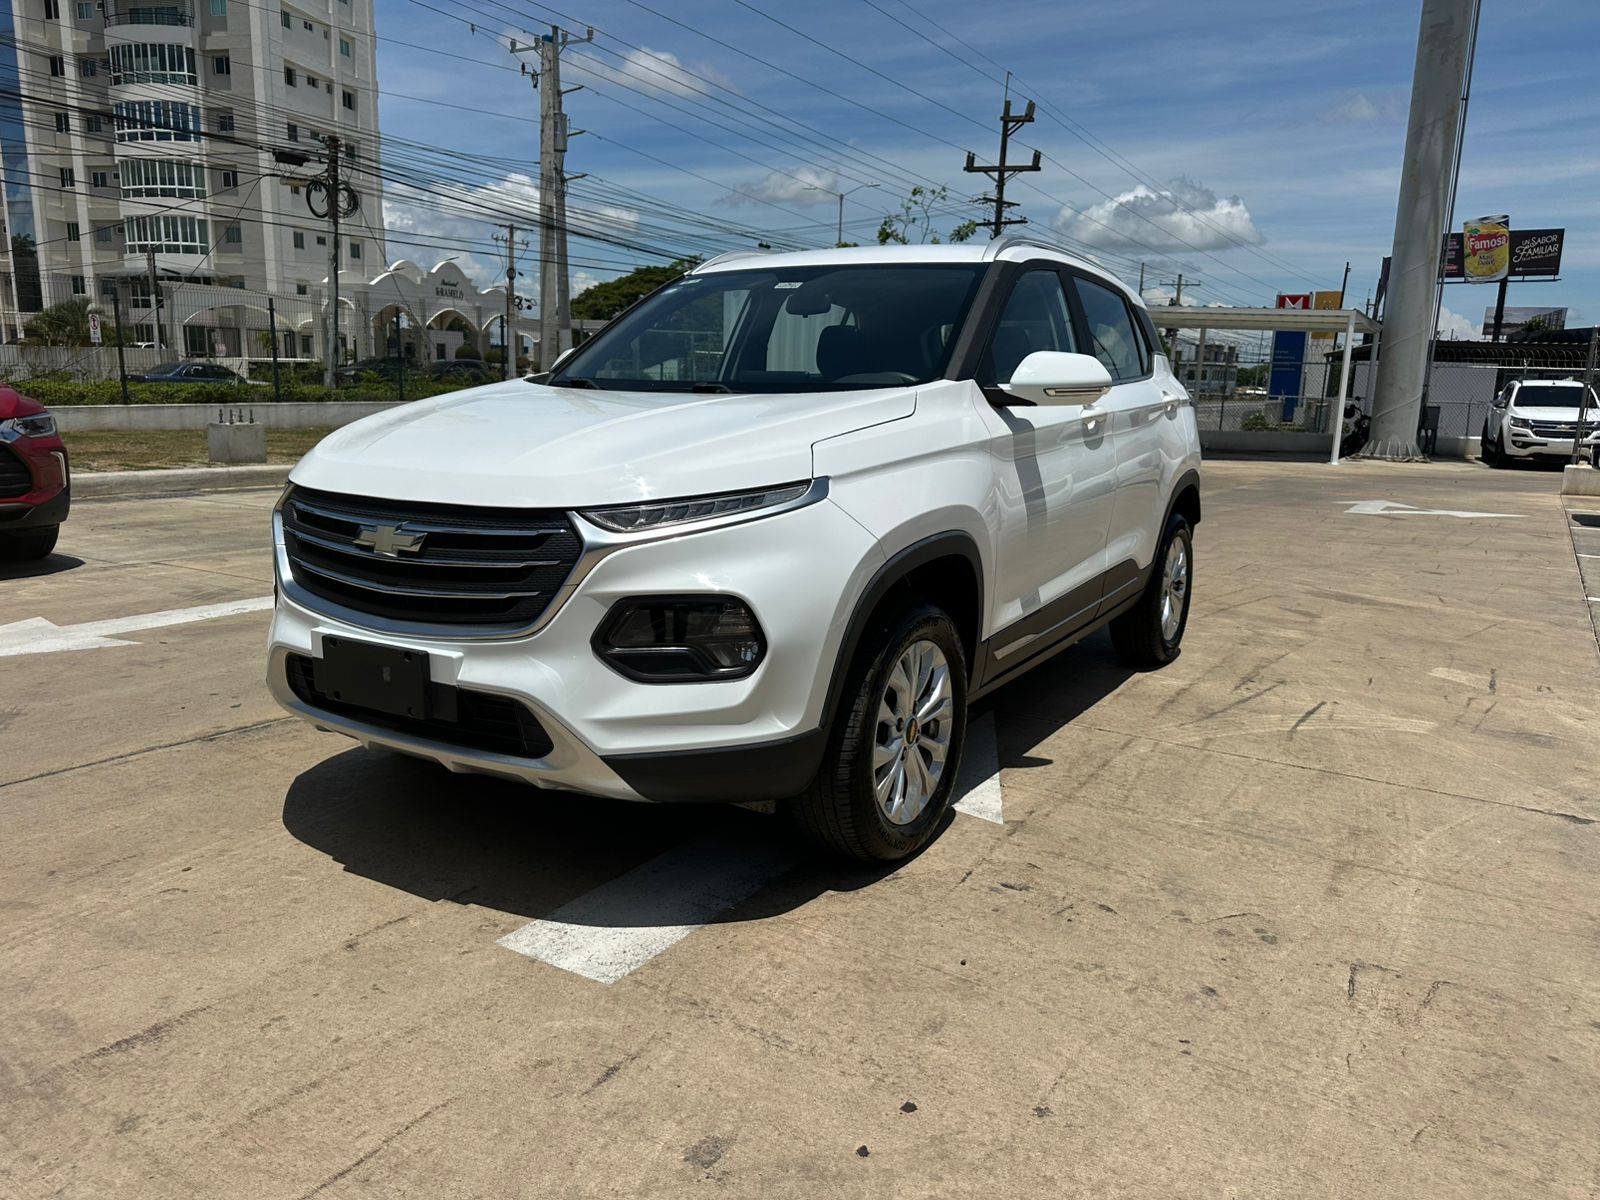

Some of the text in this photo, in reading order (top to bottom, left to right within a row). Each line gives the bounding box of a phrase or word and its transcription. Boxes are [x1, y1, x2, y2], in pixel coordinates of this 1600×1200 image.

[1469, 234, 1507, 250] Famosa
[1526, 234, 1558, 248] SABOR
[1512, 243, 1559, 263] FAMILIAR
